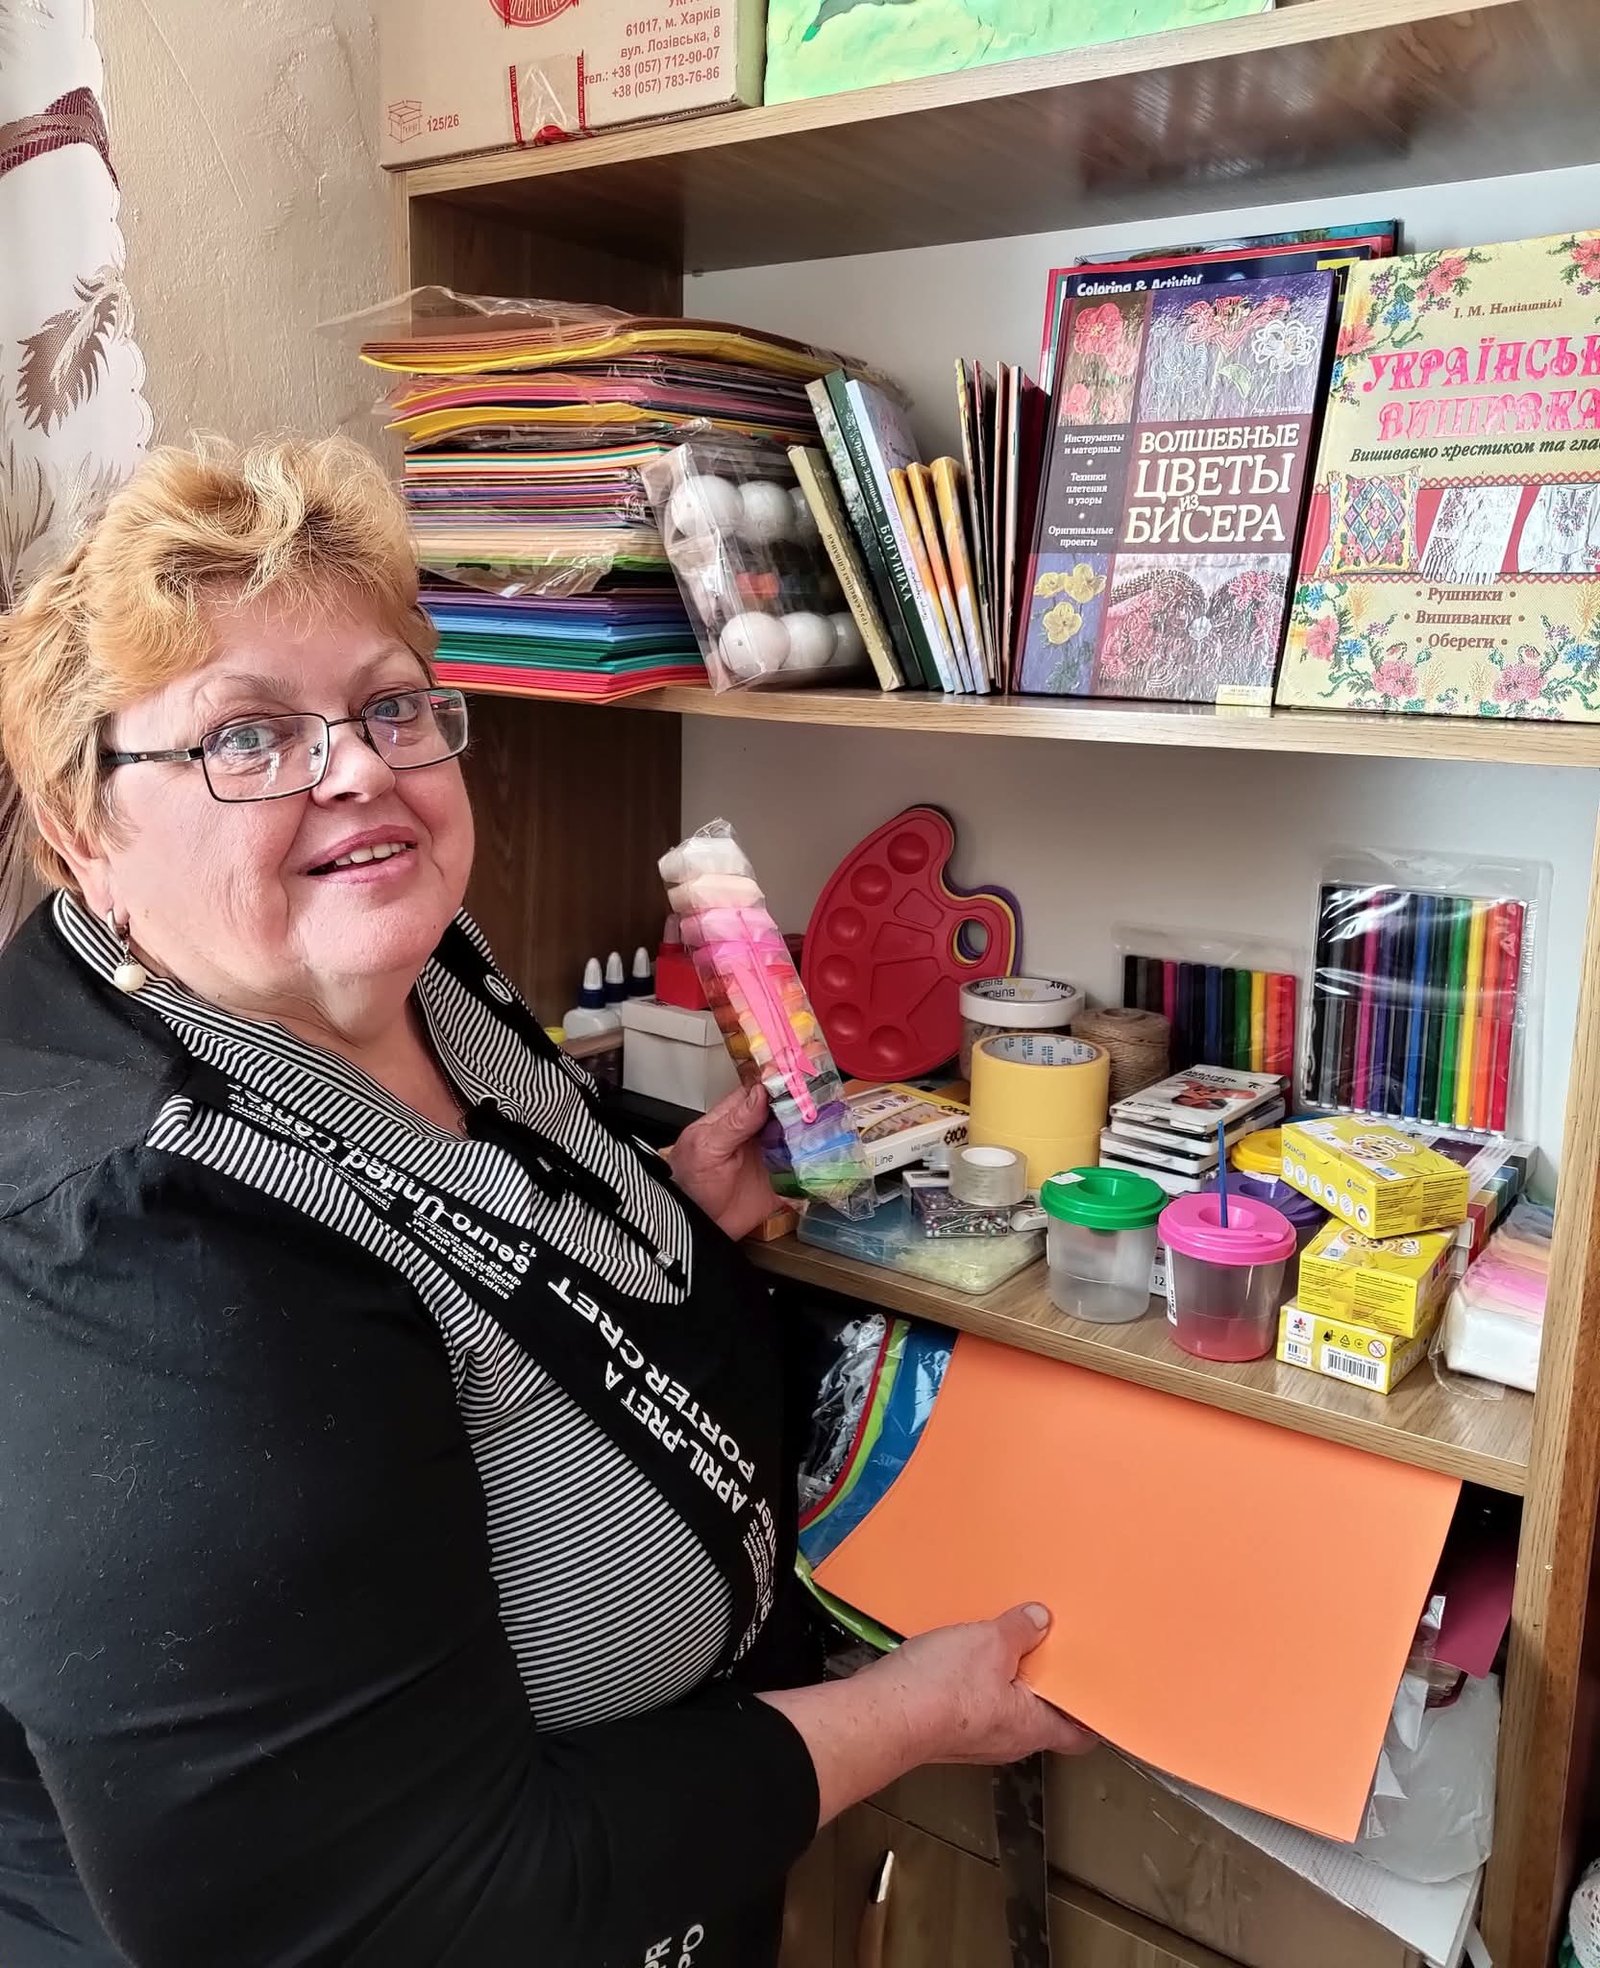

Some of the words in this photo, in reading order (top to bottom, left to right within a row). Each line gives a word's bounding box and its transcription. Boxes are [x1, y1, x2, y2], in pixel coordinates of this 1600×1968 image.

[626, 19, 662, 37] 61017,
[666, 18, 677, 28] м.
[681, 7, 720, 25] Харків
[621, 46, 643, 60] вул.
[648, 31, 709, 52] Лозівська,
[714, 25, 720, 39] 8
[612, 65, 630, 80] +38
[634, 58, 661, 78] (057)
[665, 46, 720, 69] 712-90-07
[612, 84, 631, 99] +38
[635, 78, 661, 98] (057)
[665, 66, 719, 88] 783-76-86
[1468, 305, 1485, 317] М.
[1490, 298, 1562, 315] Наніашвілі
[1362, 334, 1600, 392] УКРАЇНСЬК
[1377, 388, 1600, 441] ВИШИВКА
[1064, 432, 1125, 446] Инструменты
[1072, 443, 1121, 457] материалы
[1139, 423, 1299, 454] ВОЛШЕБНЫЕ
[1350, 446, 1438, 462] Вишиваємо
[1441, 441, 1533, 461] хрестиком
[1539, 440, 1565, 452] та
[1569, 439, 1600, 451] гла
[1066, 484, 1108, 495] плетения
[1071, 472, 1106, 482] Техники
[1133, 453, 1294, 503] ЦВЕТЫ
[1076, 495, 1103, 507] узоры
[1048, 525, 1114, 538] Оригинальные
[1124, 503, 1286, 545] БИСЕРА
[1060, 536, 1098, 548] проекты
[879, 525, 914, 603] БОГУНИХА
[1427, 587, 1503, 603] Рушники
[1415, 610, 1512, 627] Вишиванки
[1428, 633, 1495, 649] Обереги
[548, 1277, 645, 1369] CRET
[605, 1360, 624, 1391] A
[645, 1362, 755, 1483] PORTER
[620, 1386, 749, 1514] APRIL-PRET
